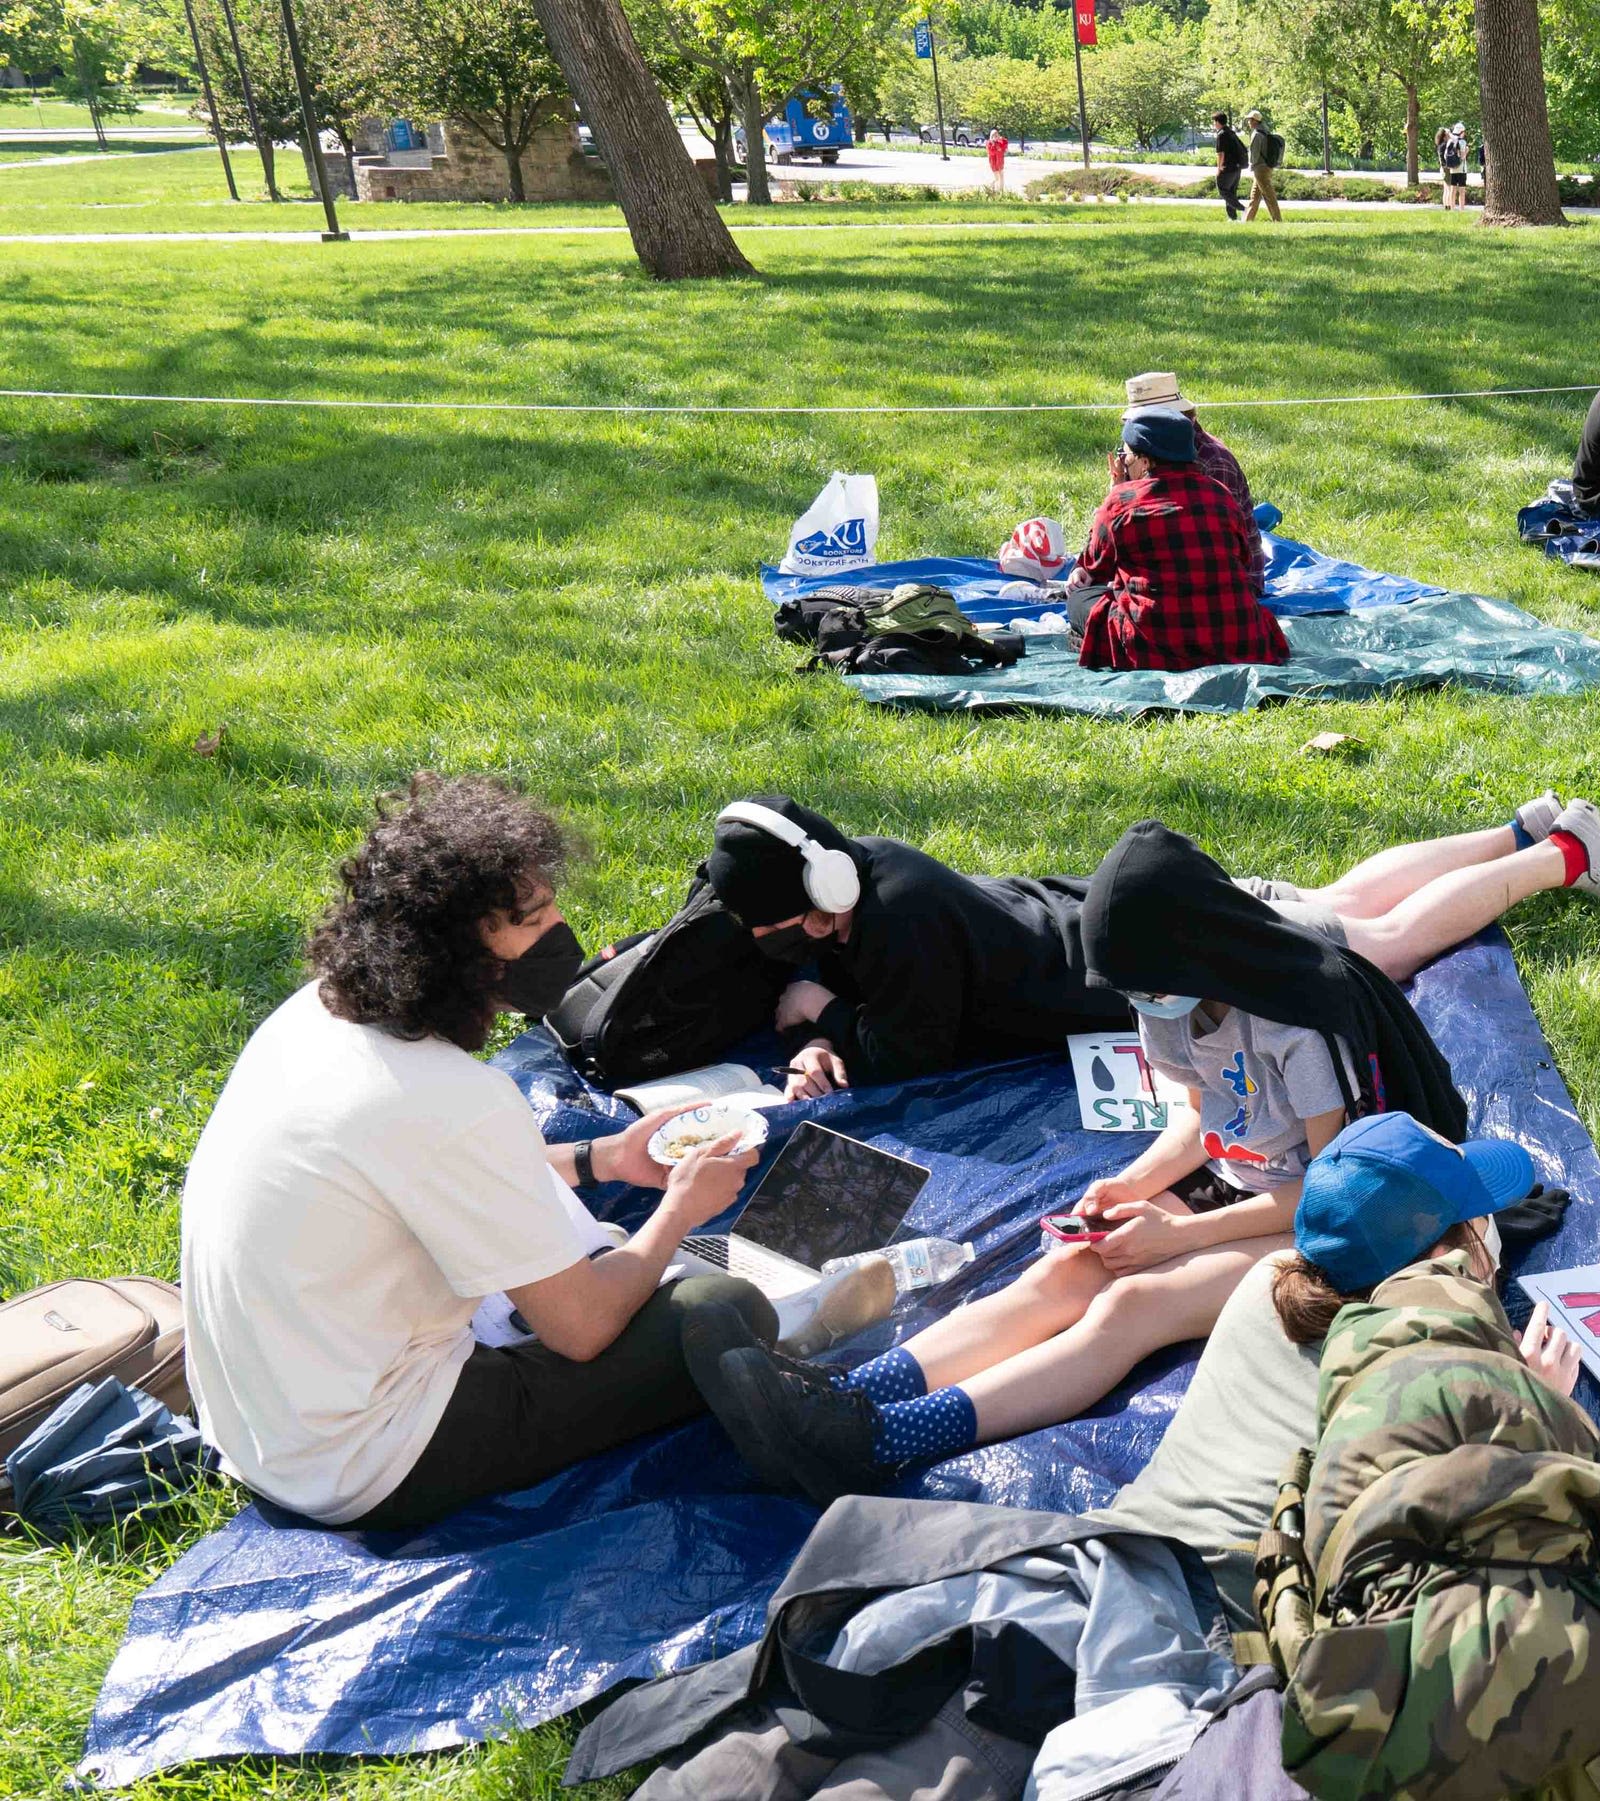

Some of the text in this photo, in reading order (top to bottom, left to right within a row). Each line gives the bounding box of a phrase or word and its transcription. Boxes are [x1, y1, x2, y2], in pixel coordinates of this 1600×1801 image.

[1080, 13, 1091, 26] KU
[824, 521, 864, 550] KU
[823, 548, 863, 557] BOOKSTORE
